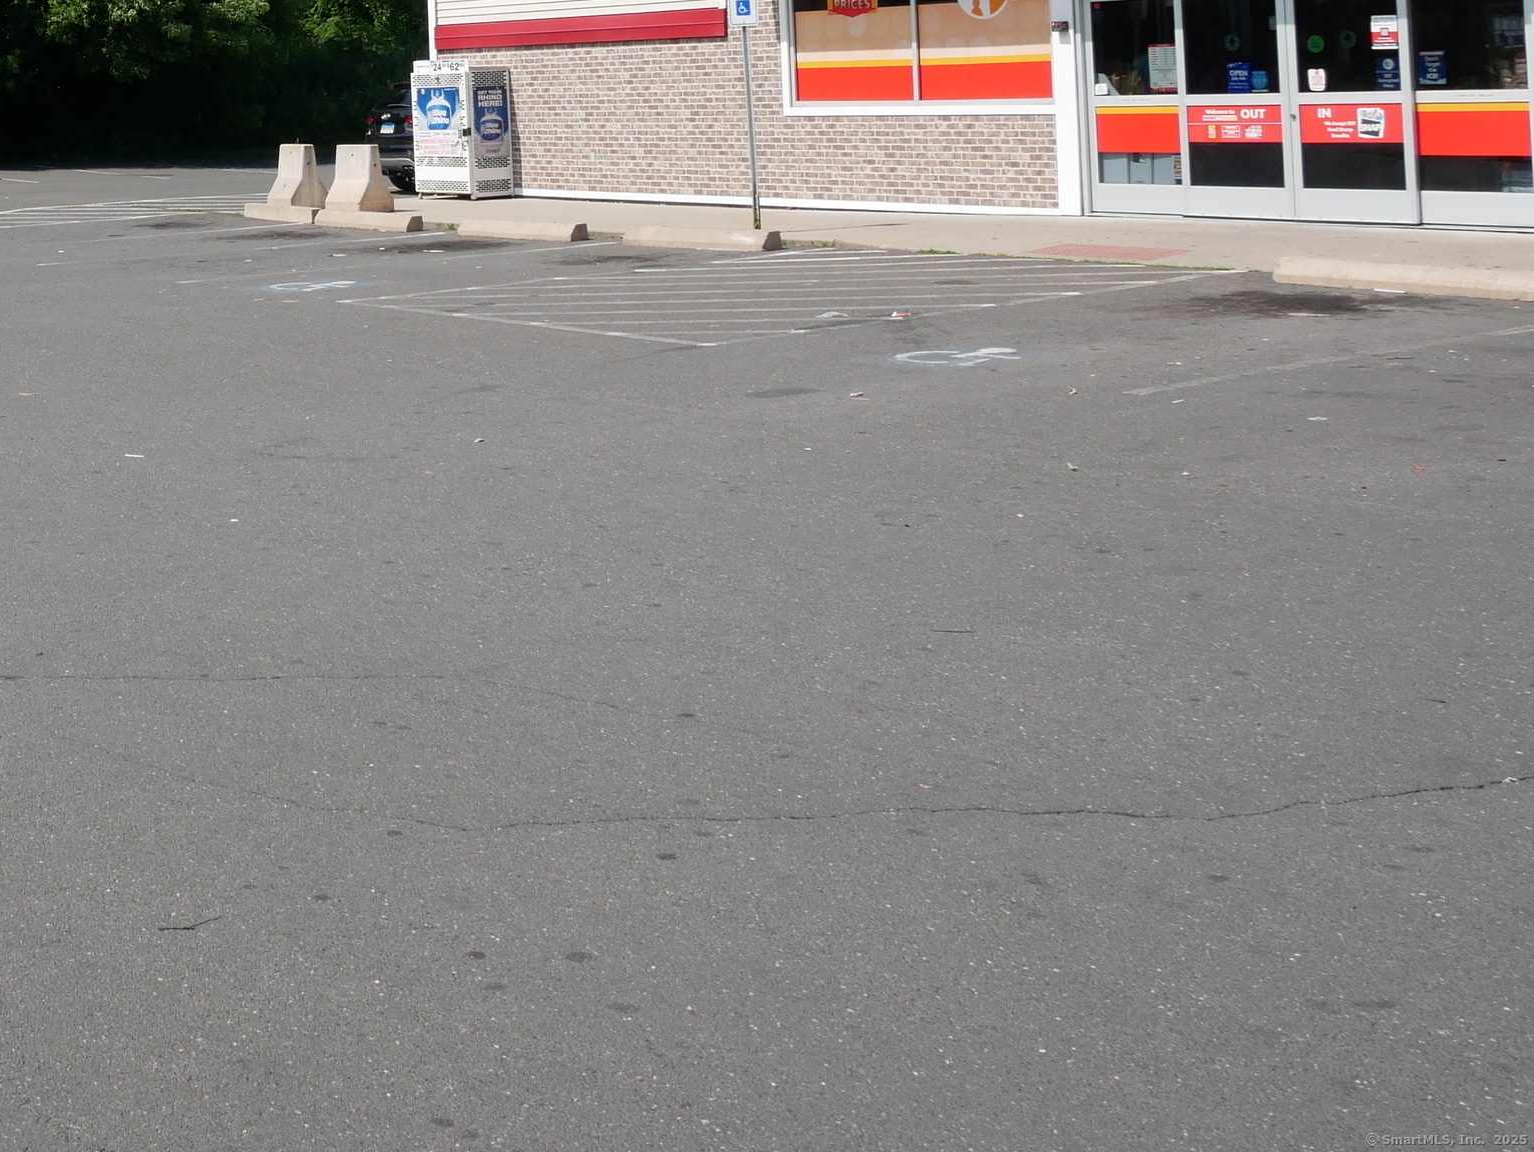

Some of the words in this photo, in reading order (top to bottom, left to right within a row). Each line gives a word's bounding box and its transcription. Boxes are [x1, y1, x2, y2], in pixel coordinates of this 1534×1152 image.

[1240, 108, 1266, 119] OUT
[1317, 108, 1332, 119] IN
[1360, 123, 1382, 132] SNAP
